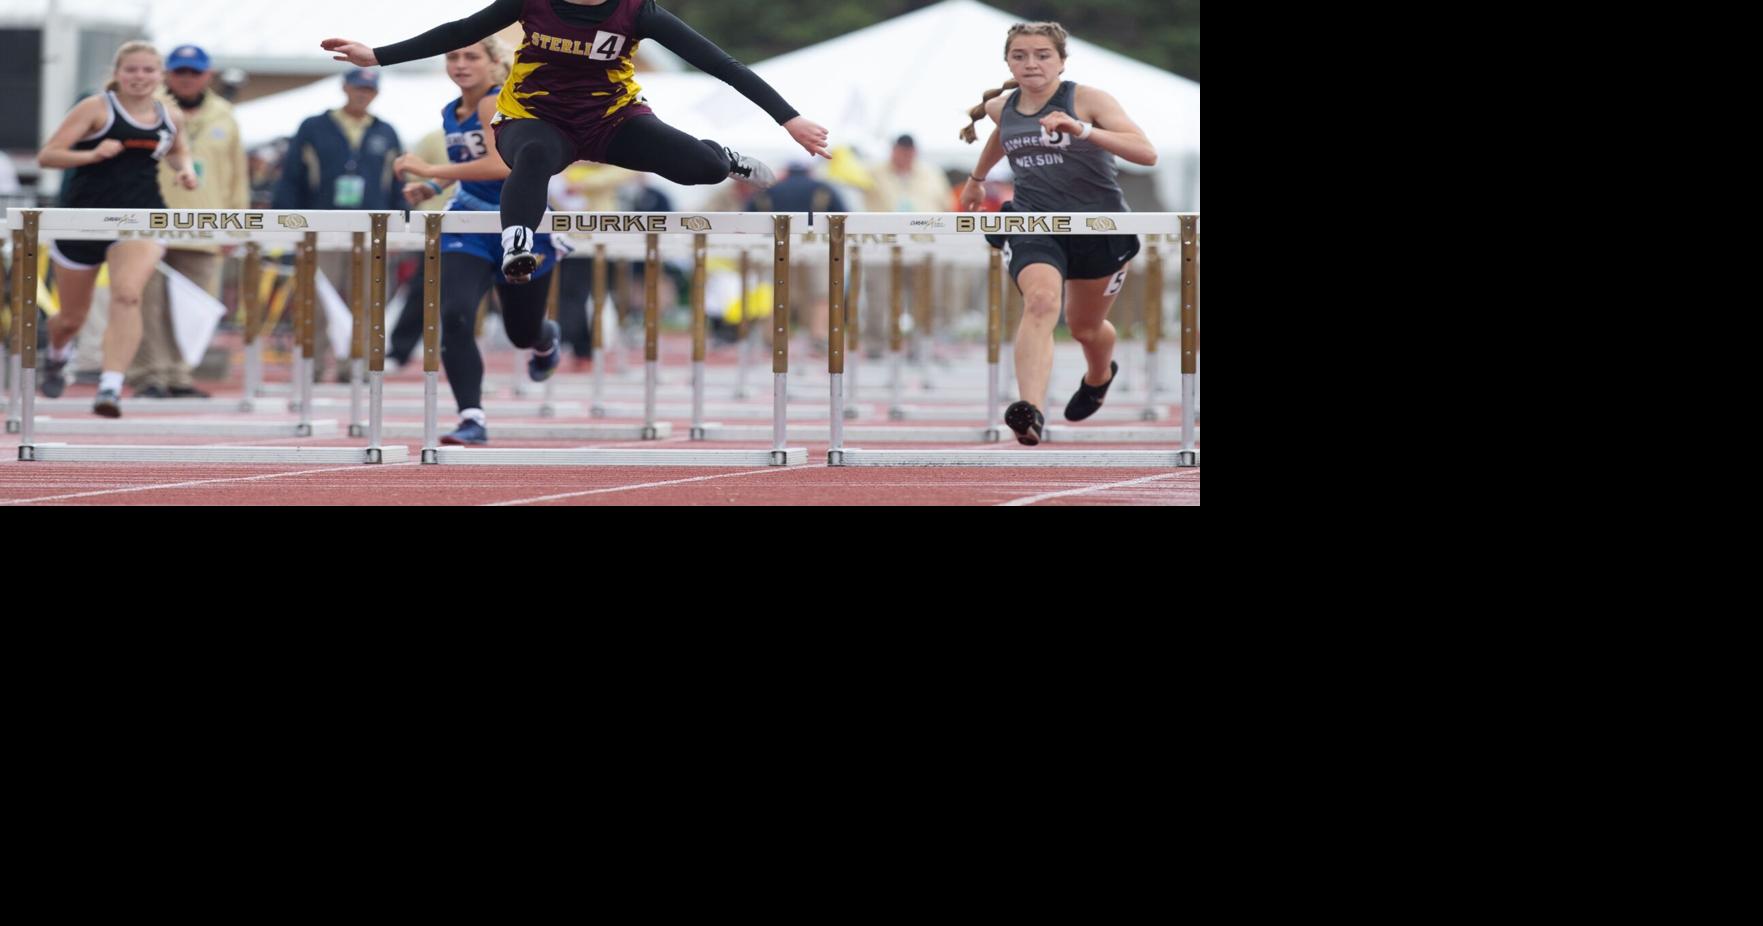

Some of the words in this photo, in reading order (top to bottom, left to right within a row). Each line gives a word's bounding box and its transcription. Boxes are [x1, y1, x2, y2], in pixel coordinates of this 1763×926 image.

[531, 31, 593, 56] STERLI
[597, 35, 619, 59] 4
[471, 133, 488, 155] 3
[1015, 152, 1065, 168] NELSON
[149, 212, 264, 229] BURKE
[552, 215, 667, 232] BURKE
[956, 215, 1072, 232] BURKE
[1110, 271, 1125, 294] 5
